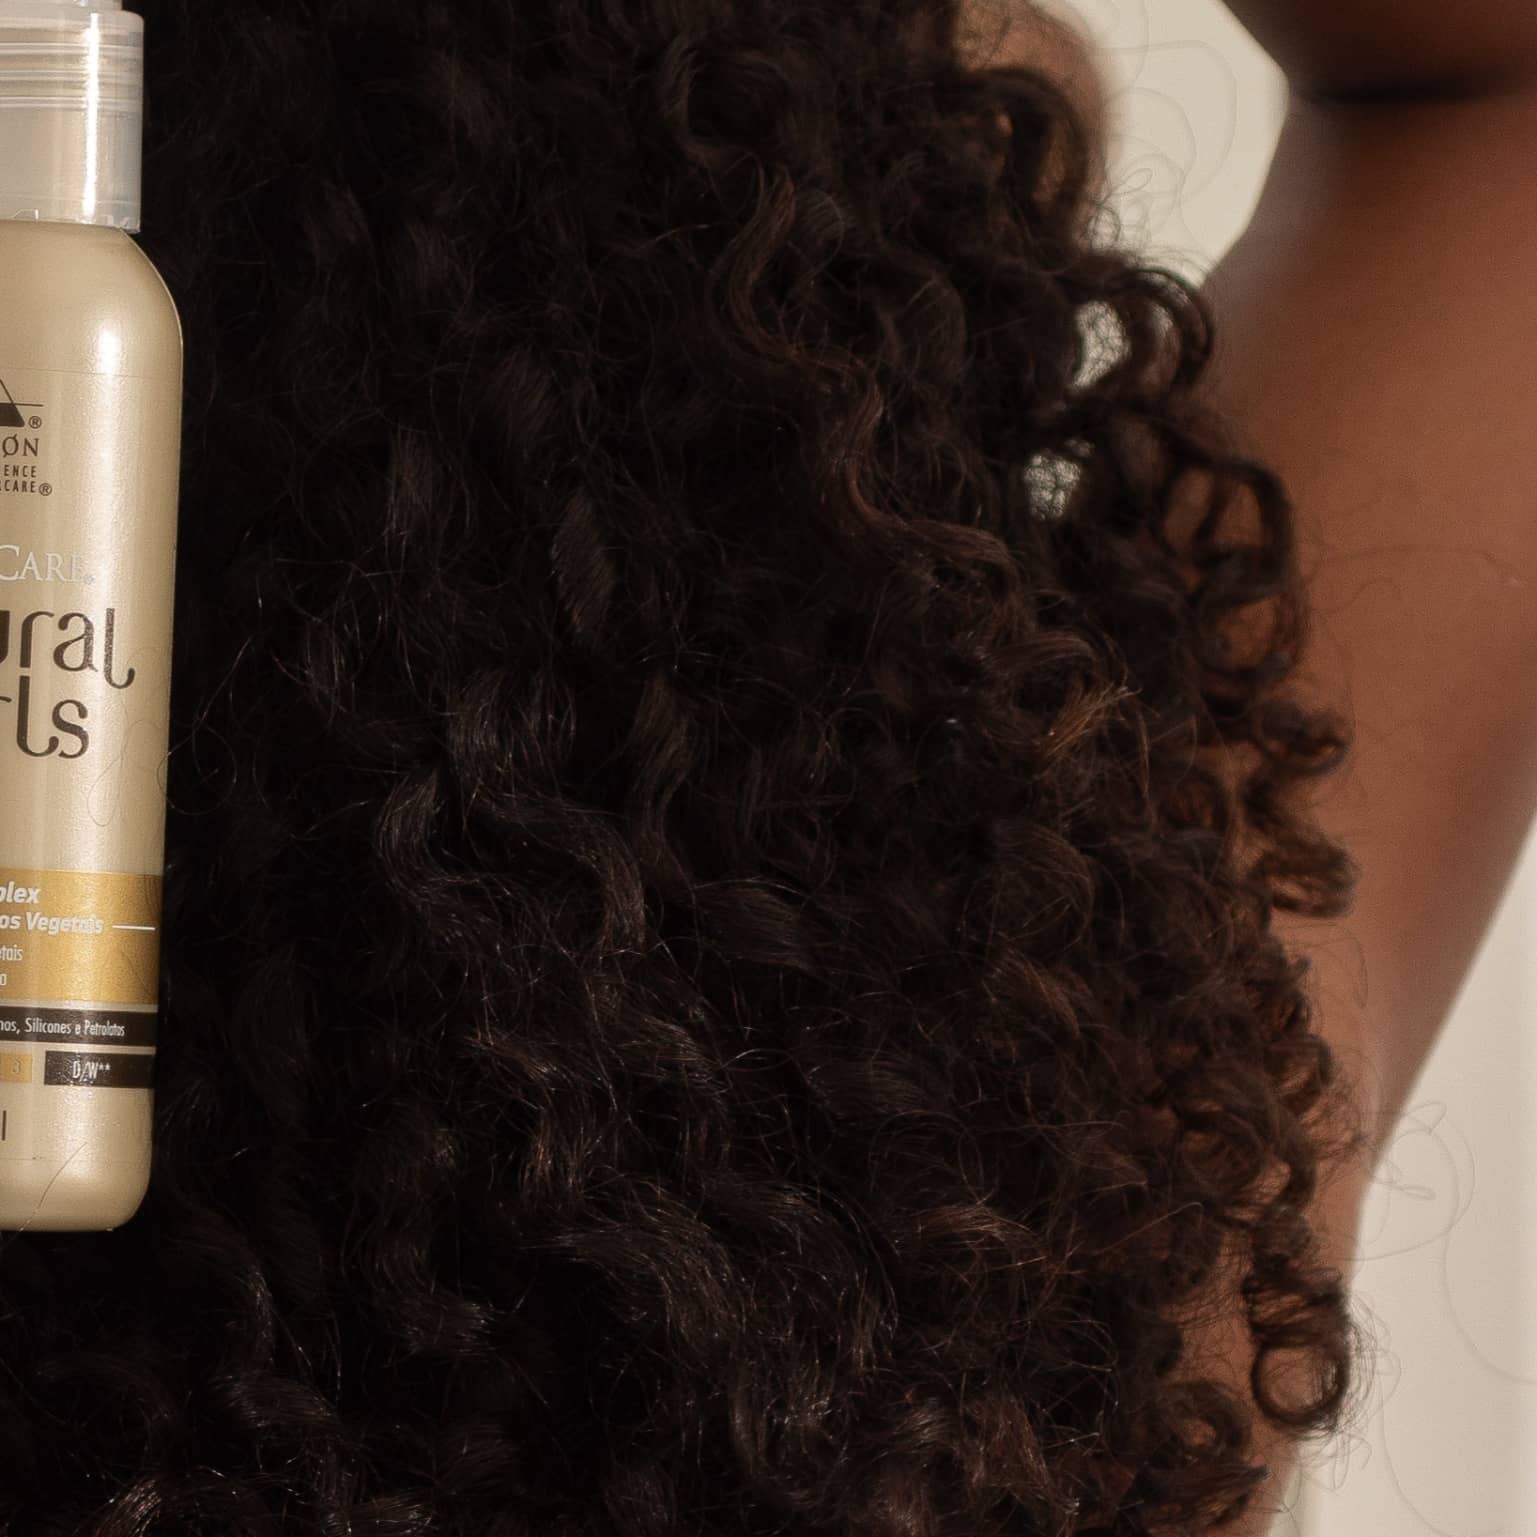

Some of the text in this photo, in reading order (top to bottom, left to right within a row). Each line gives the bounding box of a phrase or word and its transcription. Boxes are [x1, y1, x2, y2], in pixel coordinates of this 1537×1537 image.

[26, 911, 104, 936] Vegetais
[24, 1017, 72, 1036] Silicones
[74, 1026, 81, 1036] e
[13, 1059, 21, 1074] 3
